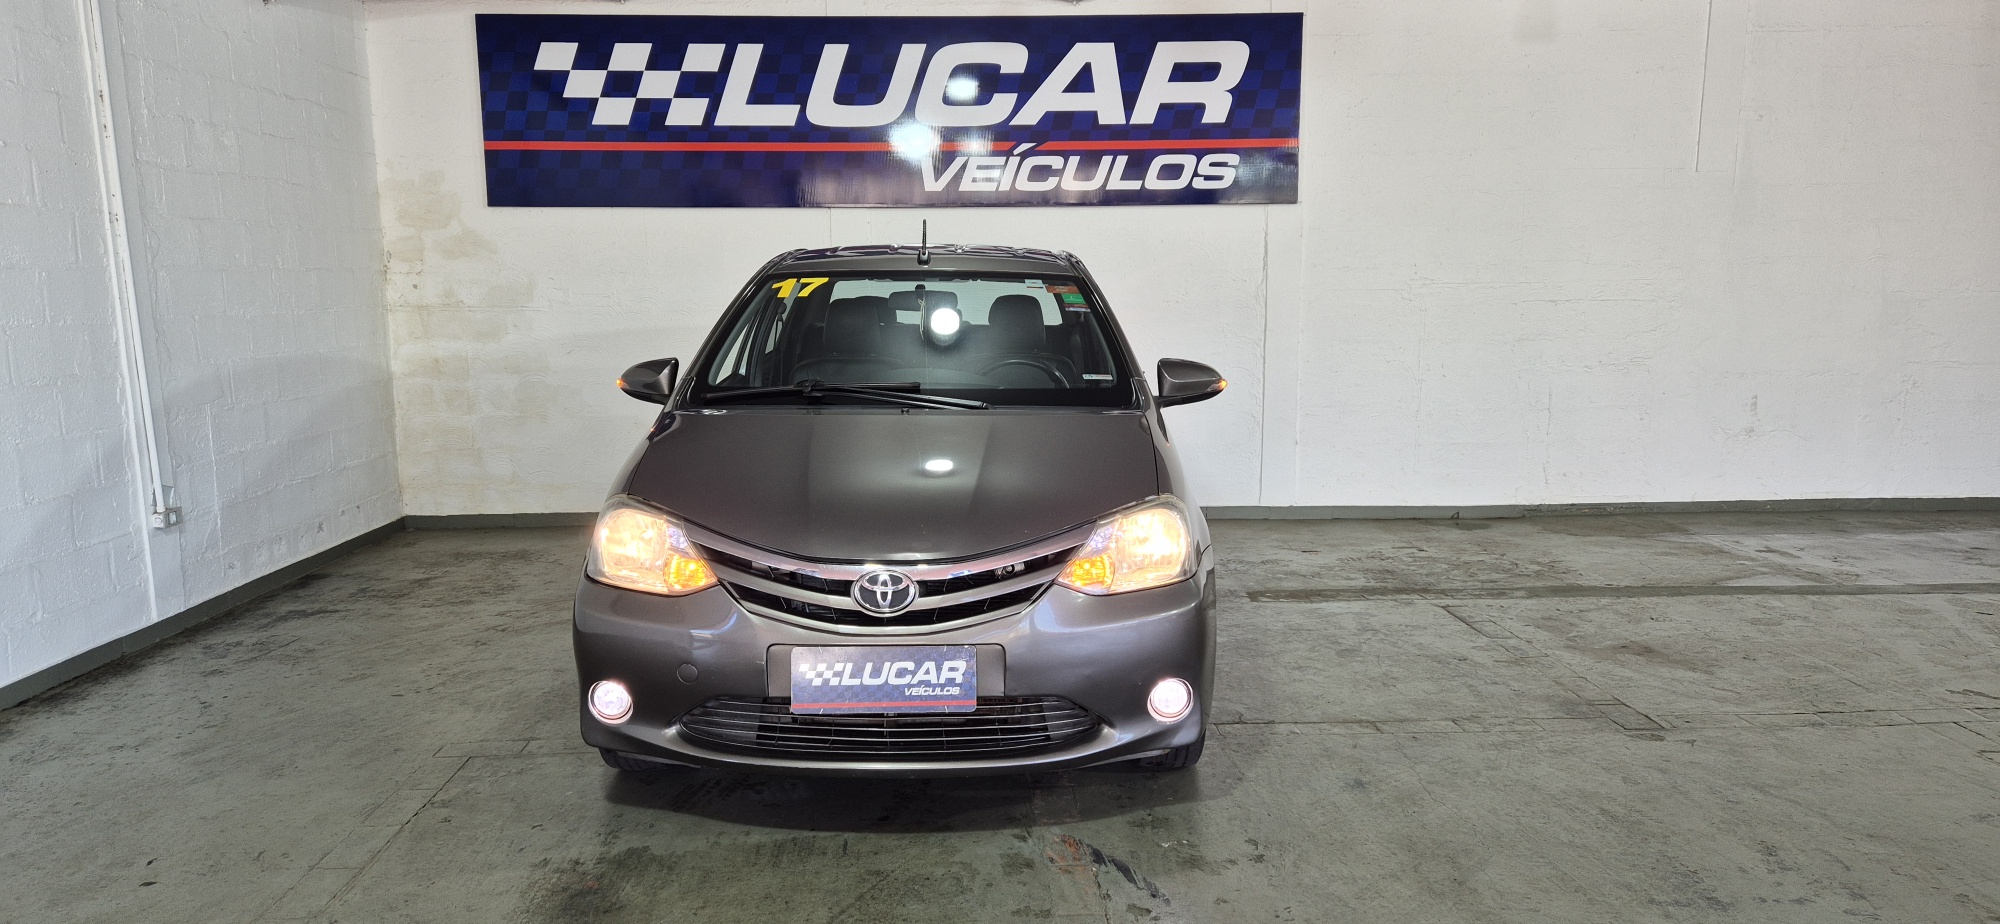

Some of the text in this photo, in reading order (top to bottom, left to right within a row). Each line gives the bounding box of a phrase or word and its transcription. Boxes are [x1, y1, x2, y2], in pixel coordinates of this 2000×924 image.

[714, 41, 1250, 127] LUCAR
[918, 143, 1240, 191] VEÍCULOS
[772, 278, 829, 298] 17
[840, 661, 967, 686] LUCAR
[904, 685, 961, 696] VEÍCULOS
